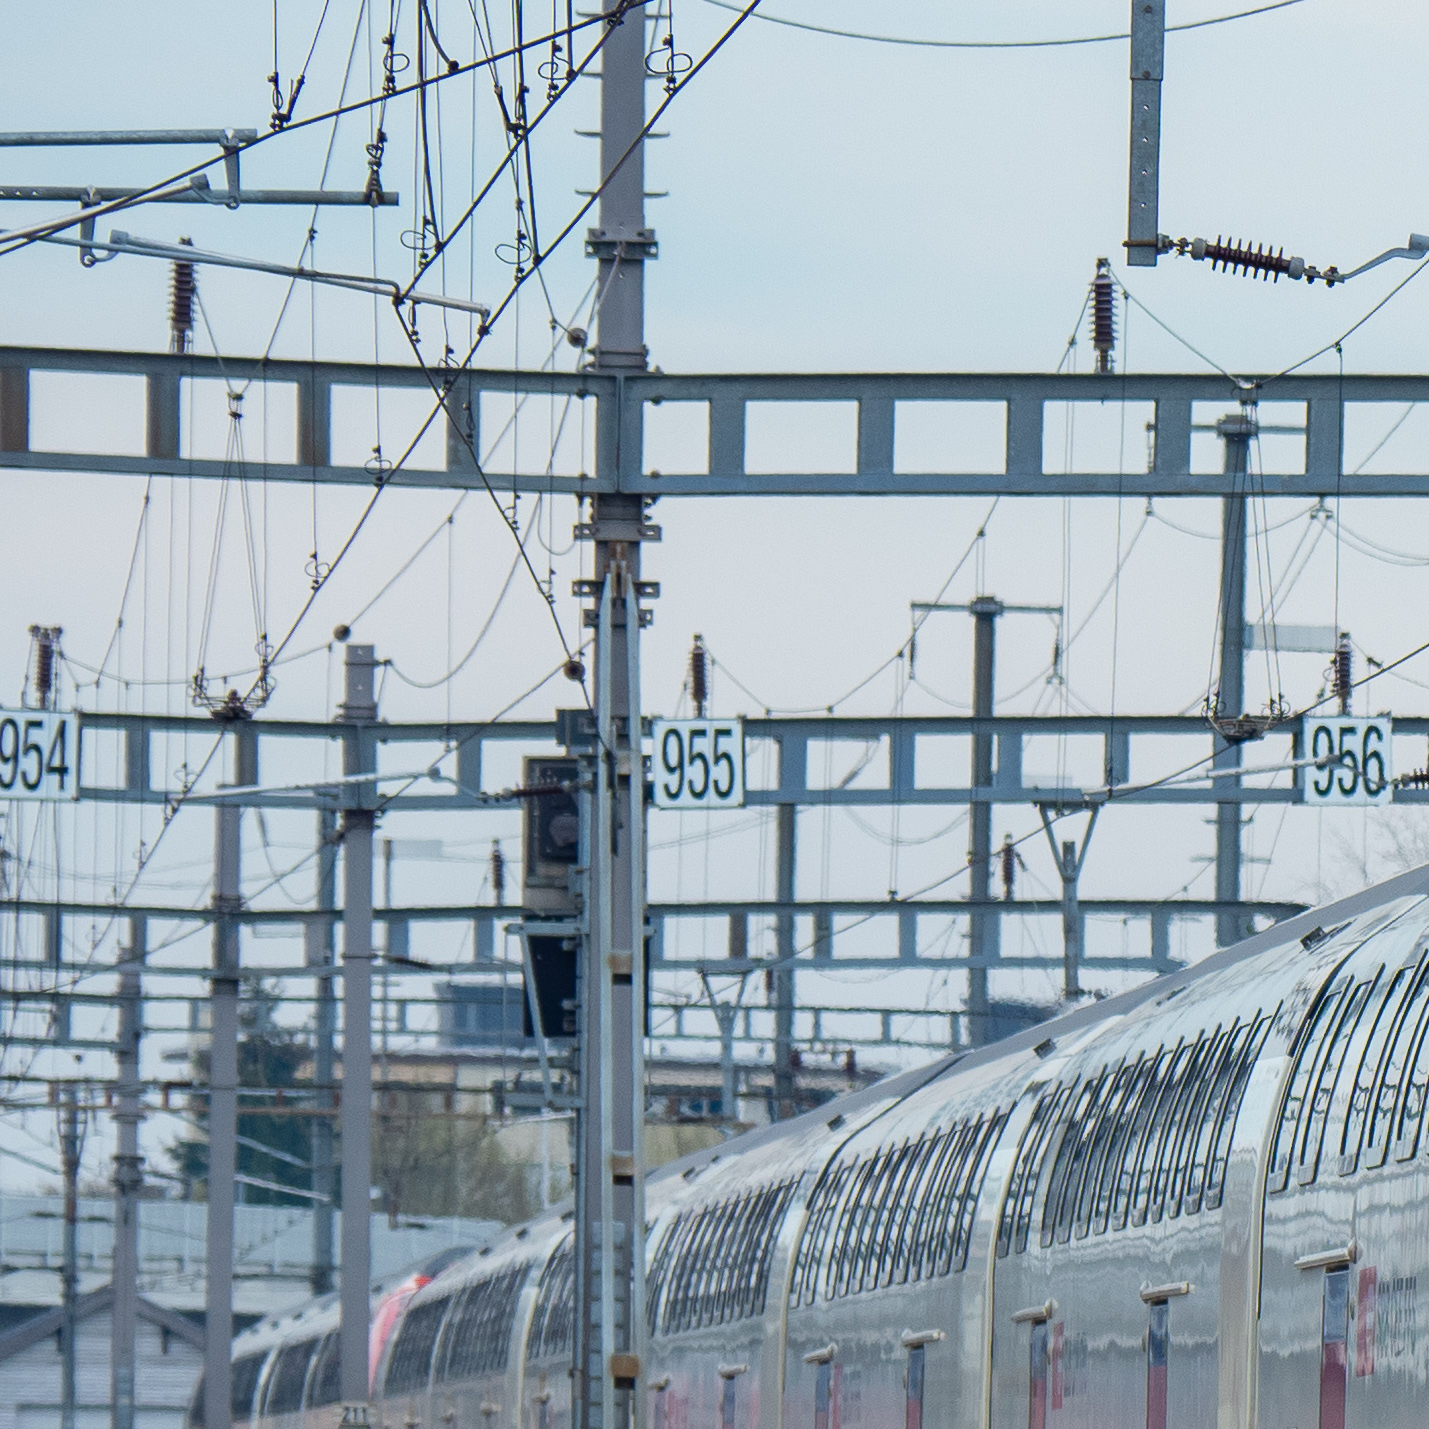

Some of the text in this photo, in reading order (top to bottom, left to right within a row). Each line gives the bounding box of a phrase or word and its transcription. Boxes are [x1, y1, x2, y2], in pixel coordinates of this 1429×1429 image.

[0, 718, 68, 790] 954
[662, 728, 735, 800] 955
[1313, 725, 1386, 798] 956
